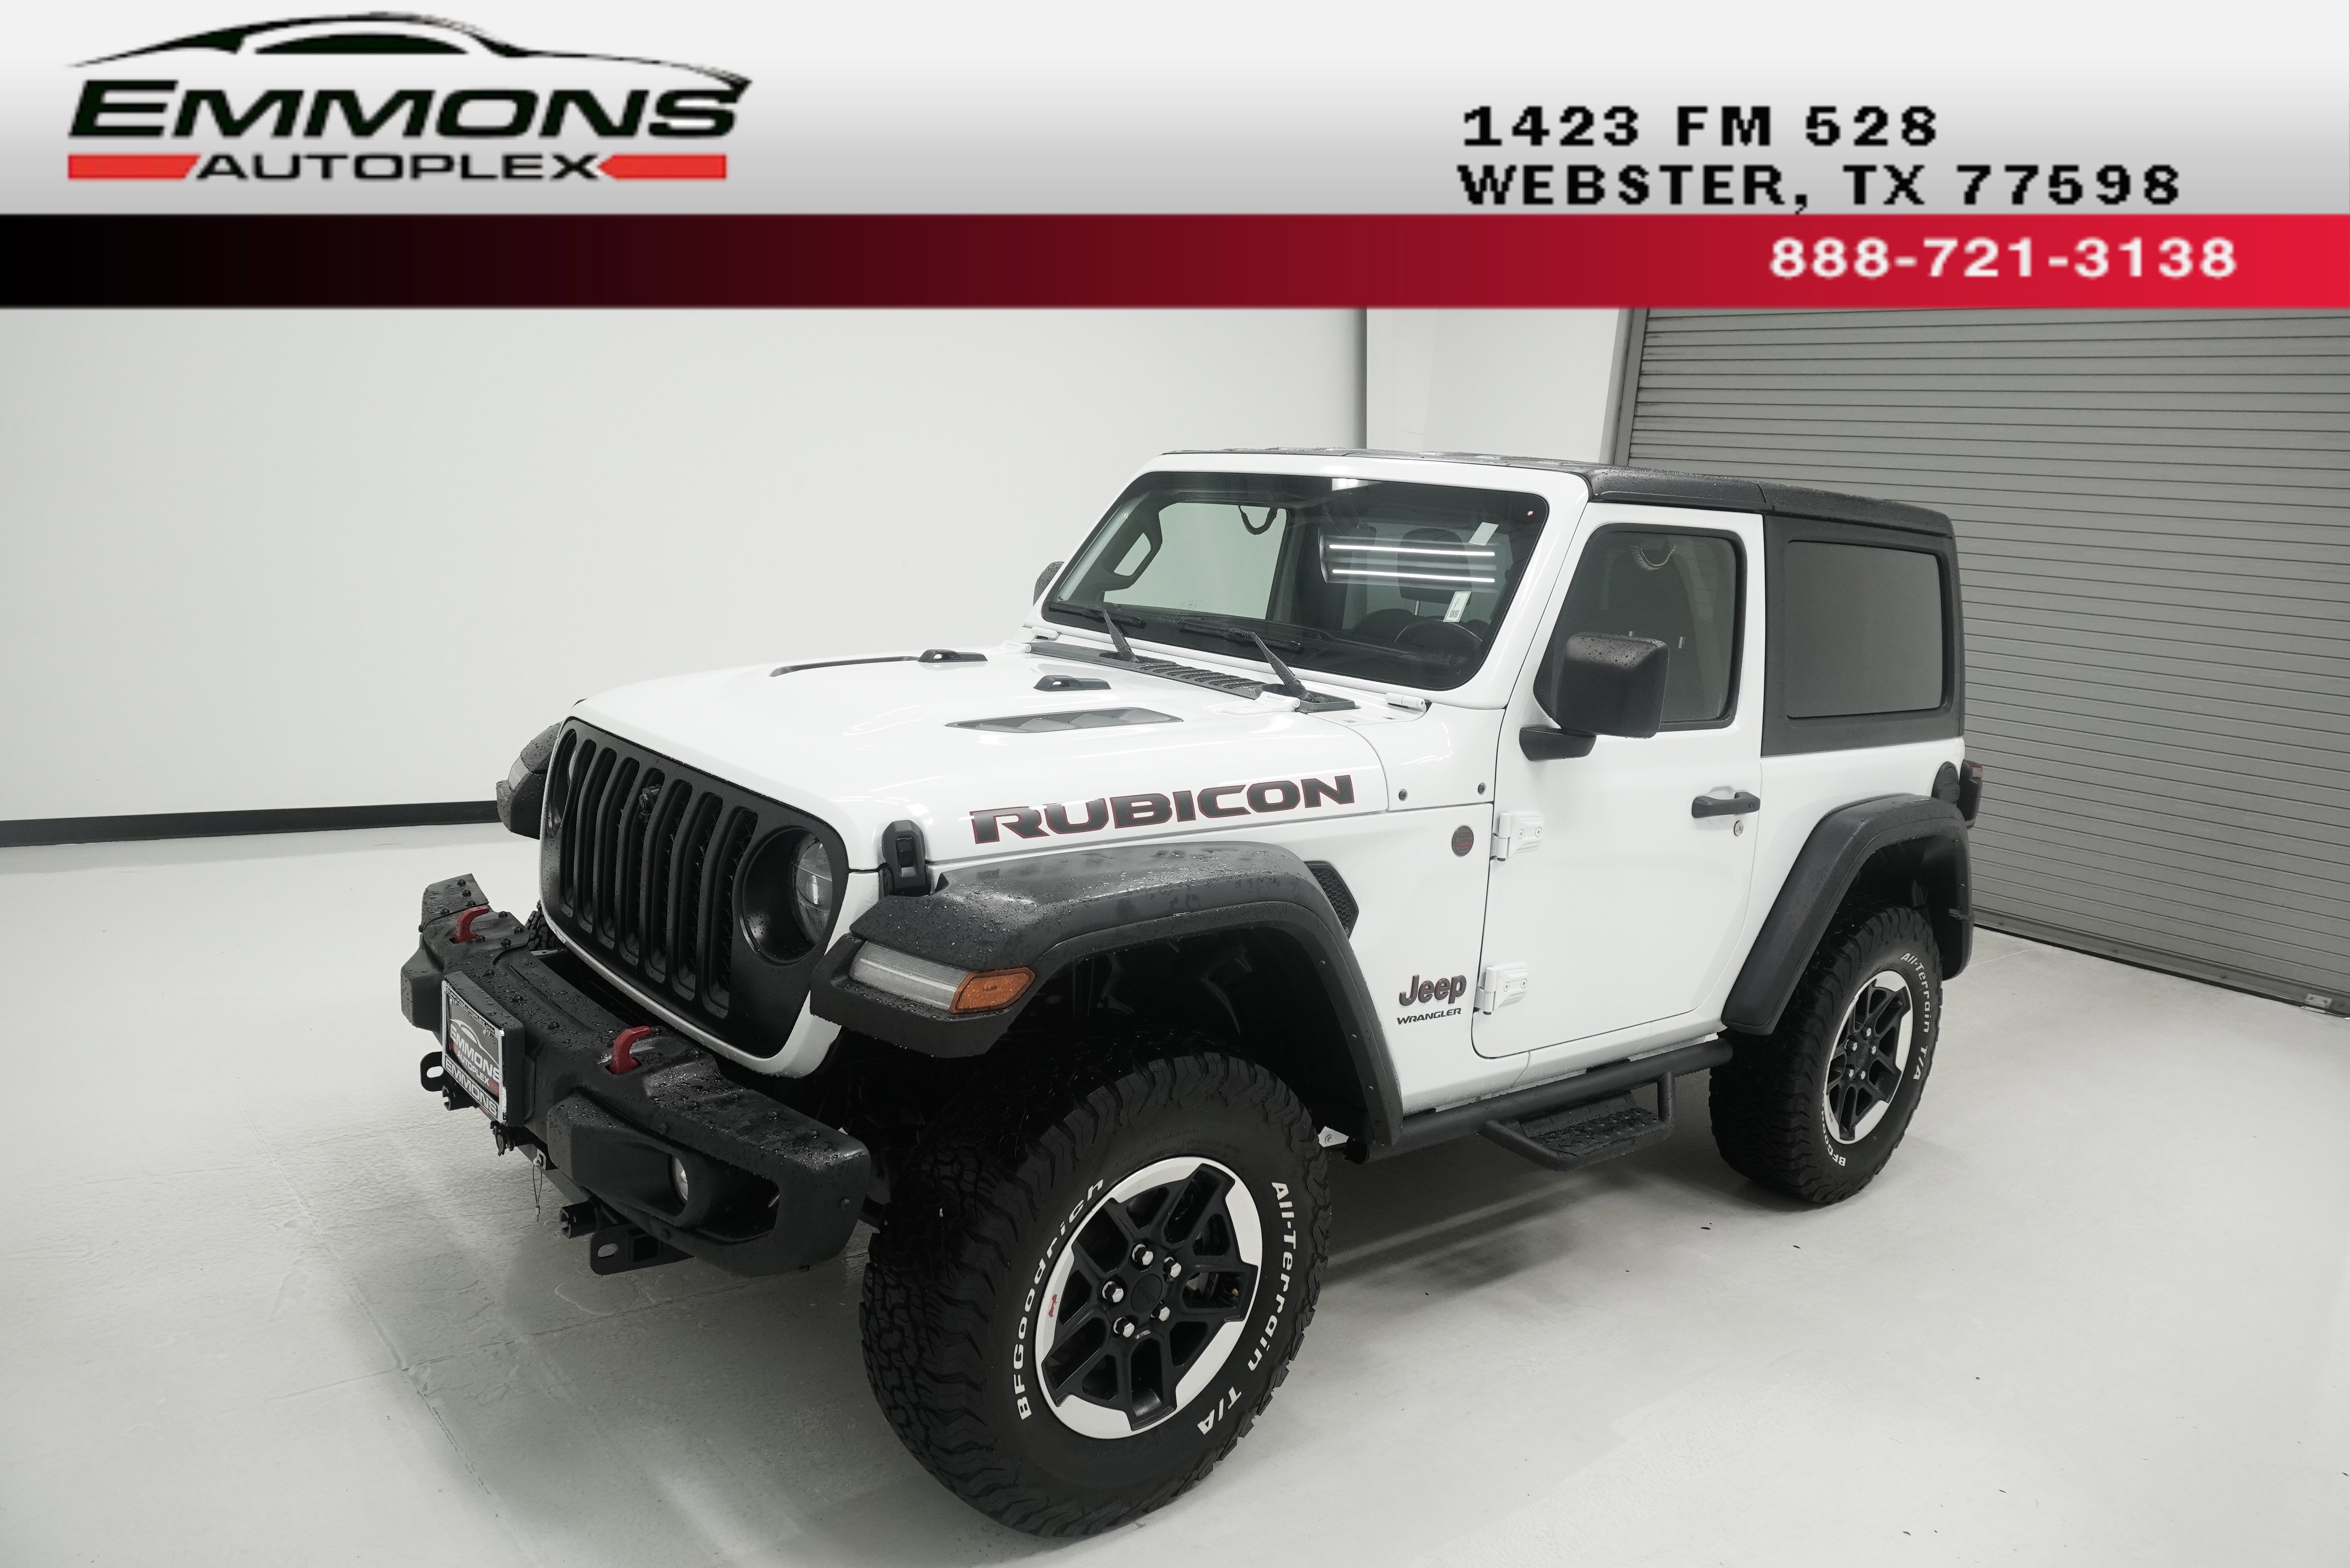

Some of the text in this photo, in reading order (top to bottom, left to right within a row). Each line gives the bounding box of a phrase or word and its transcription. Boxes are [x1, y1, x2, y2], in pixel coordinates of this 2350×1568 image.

[969, 774, 1355, 844] RUBICON
[1396, 1008, 1461, 1025] WRANGLER
[1399, 975, 1467, 1006] Jeep
[1900, 952, 1932, 1080] All-Terrain T/A
[450, 1022, 500, 1084] EMMONS
[457, 1050, 490, 1086] AUTOPLEX
[445, 1057, 498, 1117] EMMONS
[1013, 1179, 1104, 1420] BFGoodrich
[1197, 1182, 1296, 1435] All-Terrain T/A
